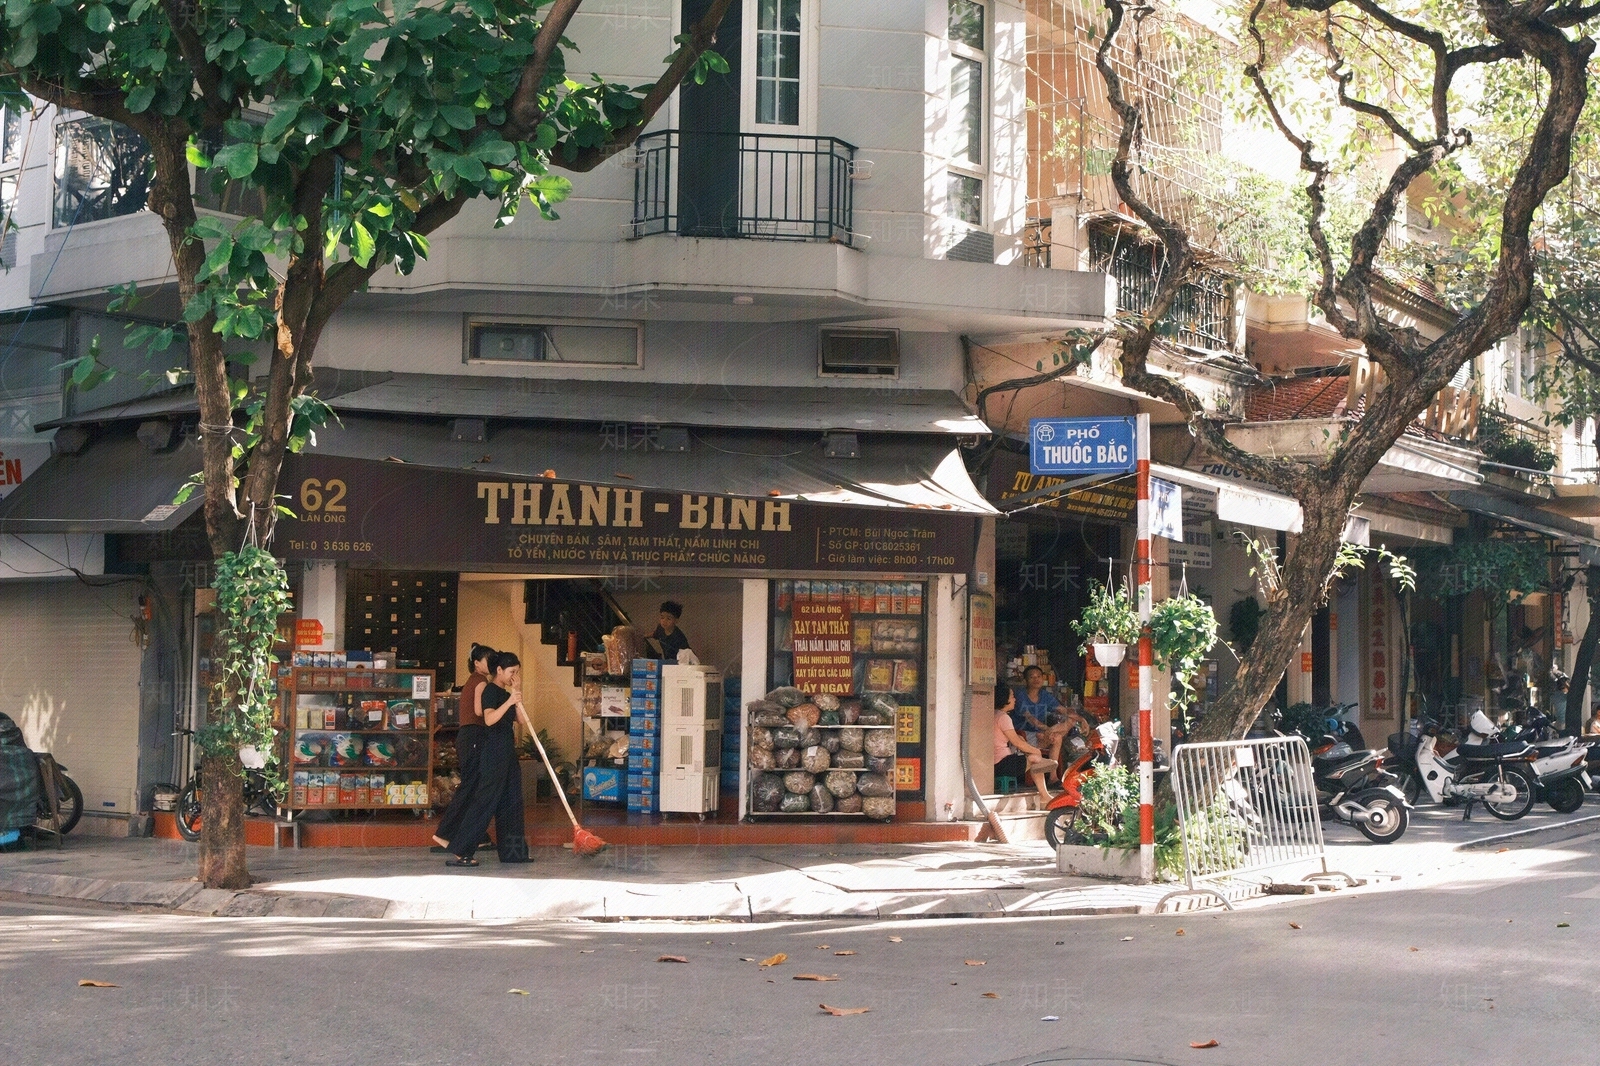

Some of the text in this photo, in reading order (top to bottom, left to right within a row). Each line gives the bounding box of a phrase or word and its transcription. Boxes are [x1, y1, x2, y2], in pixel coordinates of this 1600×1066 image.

[1067, 424, 1100, 439] PHỐ
[1043, 439, 1128, 464] THUỐC BẮC
[300, 477, 347, 512] 62
[518, 532, 564, 545] CHUYÊN
[628, 536, 650, 547] TAM
[684, 534, 710, 549] NẤM
[712, 538, 737, 549] LINH
[740, 539, 760, 550] CHI
[883, 528, 909, 540] Ngọc
[828, 539, 842, 550] Số
[552, 546, 586, 560] NƯỚC
[589, 545, 610, 560] YẾN
[612, 548, 628, 561] VÀ
[631, 549, 660, 564] THỰC
[698, 549, 731, 563] CHỨC
[733, 552, 766, 564] NĂNG
[848, 554, 865, 564] làm
[894, 555, 917, 564] 8h00
[926, 556, 955, 566] 17h00
[794, 614, 850, 635] XAY TAM THẤT
[825, 639, 839, 652] LINH
[840, 639, 851, 652] CHI
[795, 668, 806, 678] XAY
[820, 683, 851, 693] NGAY
